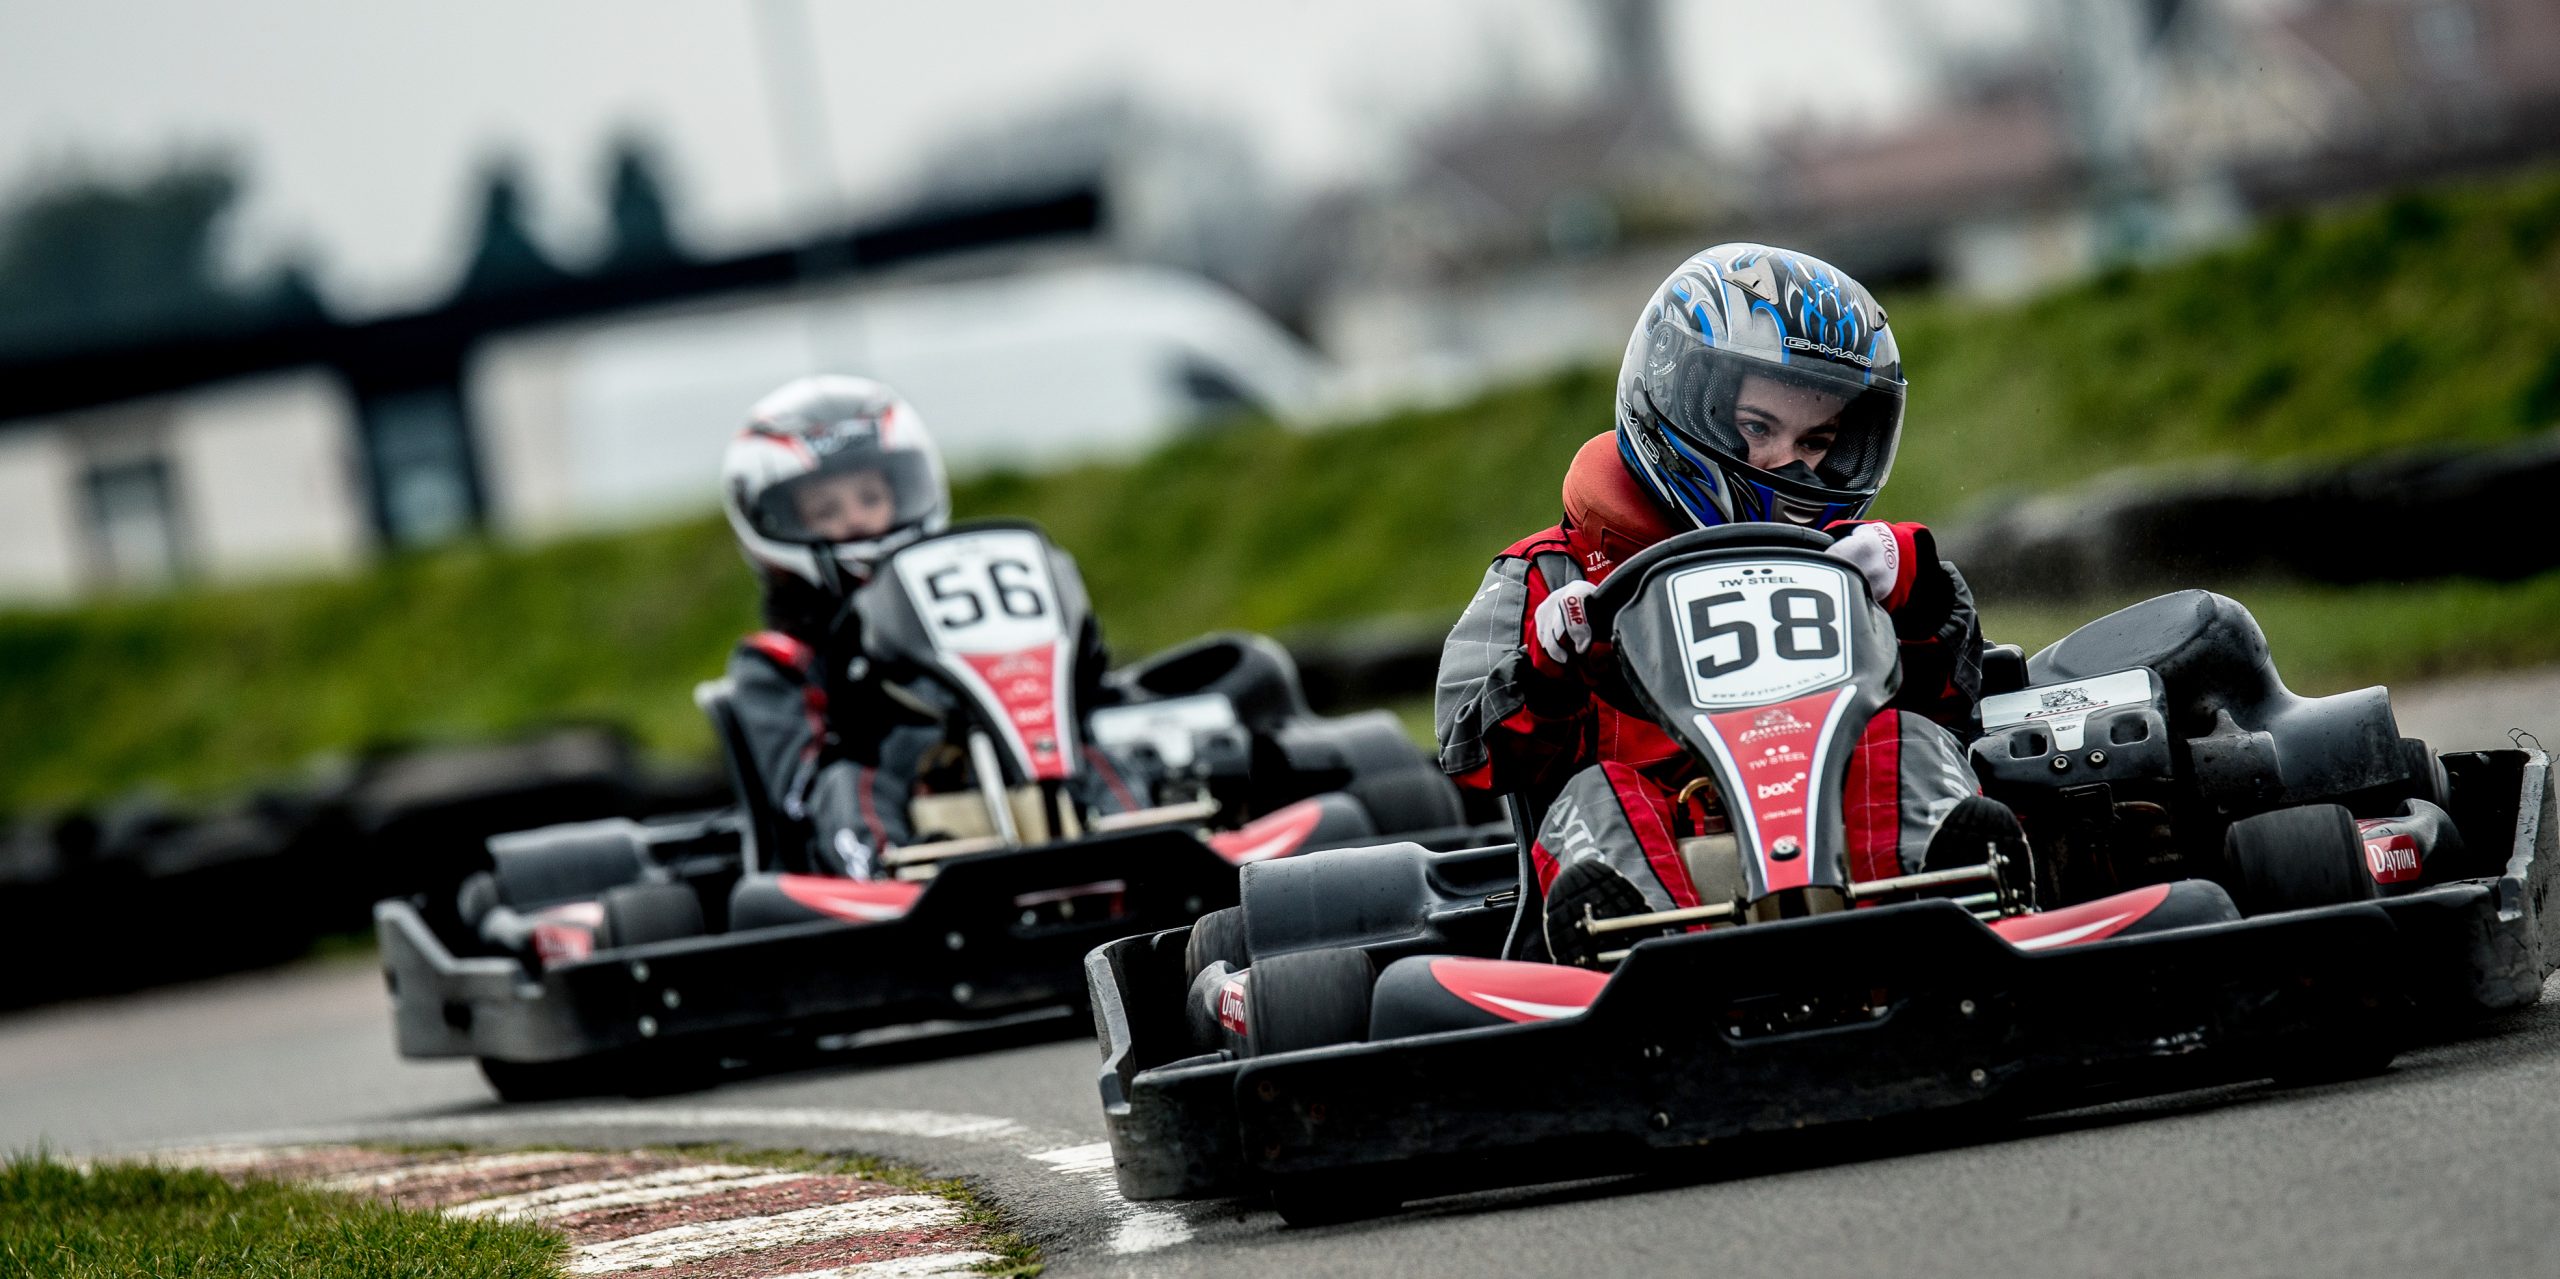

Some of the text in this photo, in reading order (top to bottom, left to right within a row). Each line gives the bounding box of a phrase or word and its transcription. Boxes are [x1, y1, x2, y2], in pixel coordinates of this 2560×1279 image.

[925, 559, 1045, 630] 56
[1719, 575, 1799, 589] TW STEEL
[1566, 595, 1584, 625] OMP
[1687, 588, 1841, 681] 58
[1748, 751, 1809, 770] TW STEEL
[2367, 843, 2418, 879] DAYTONA
